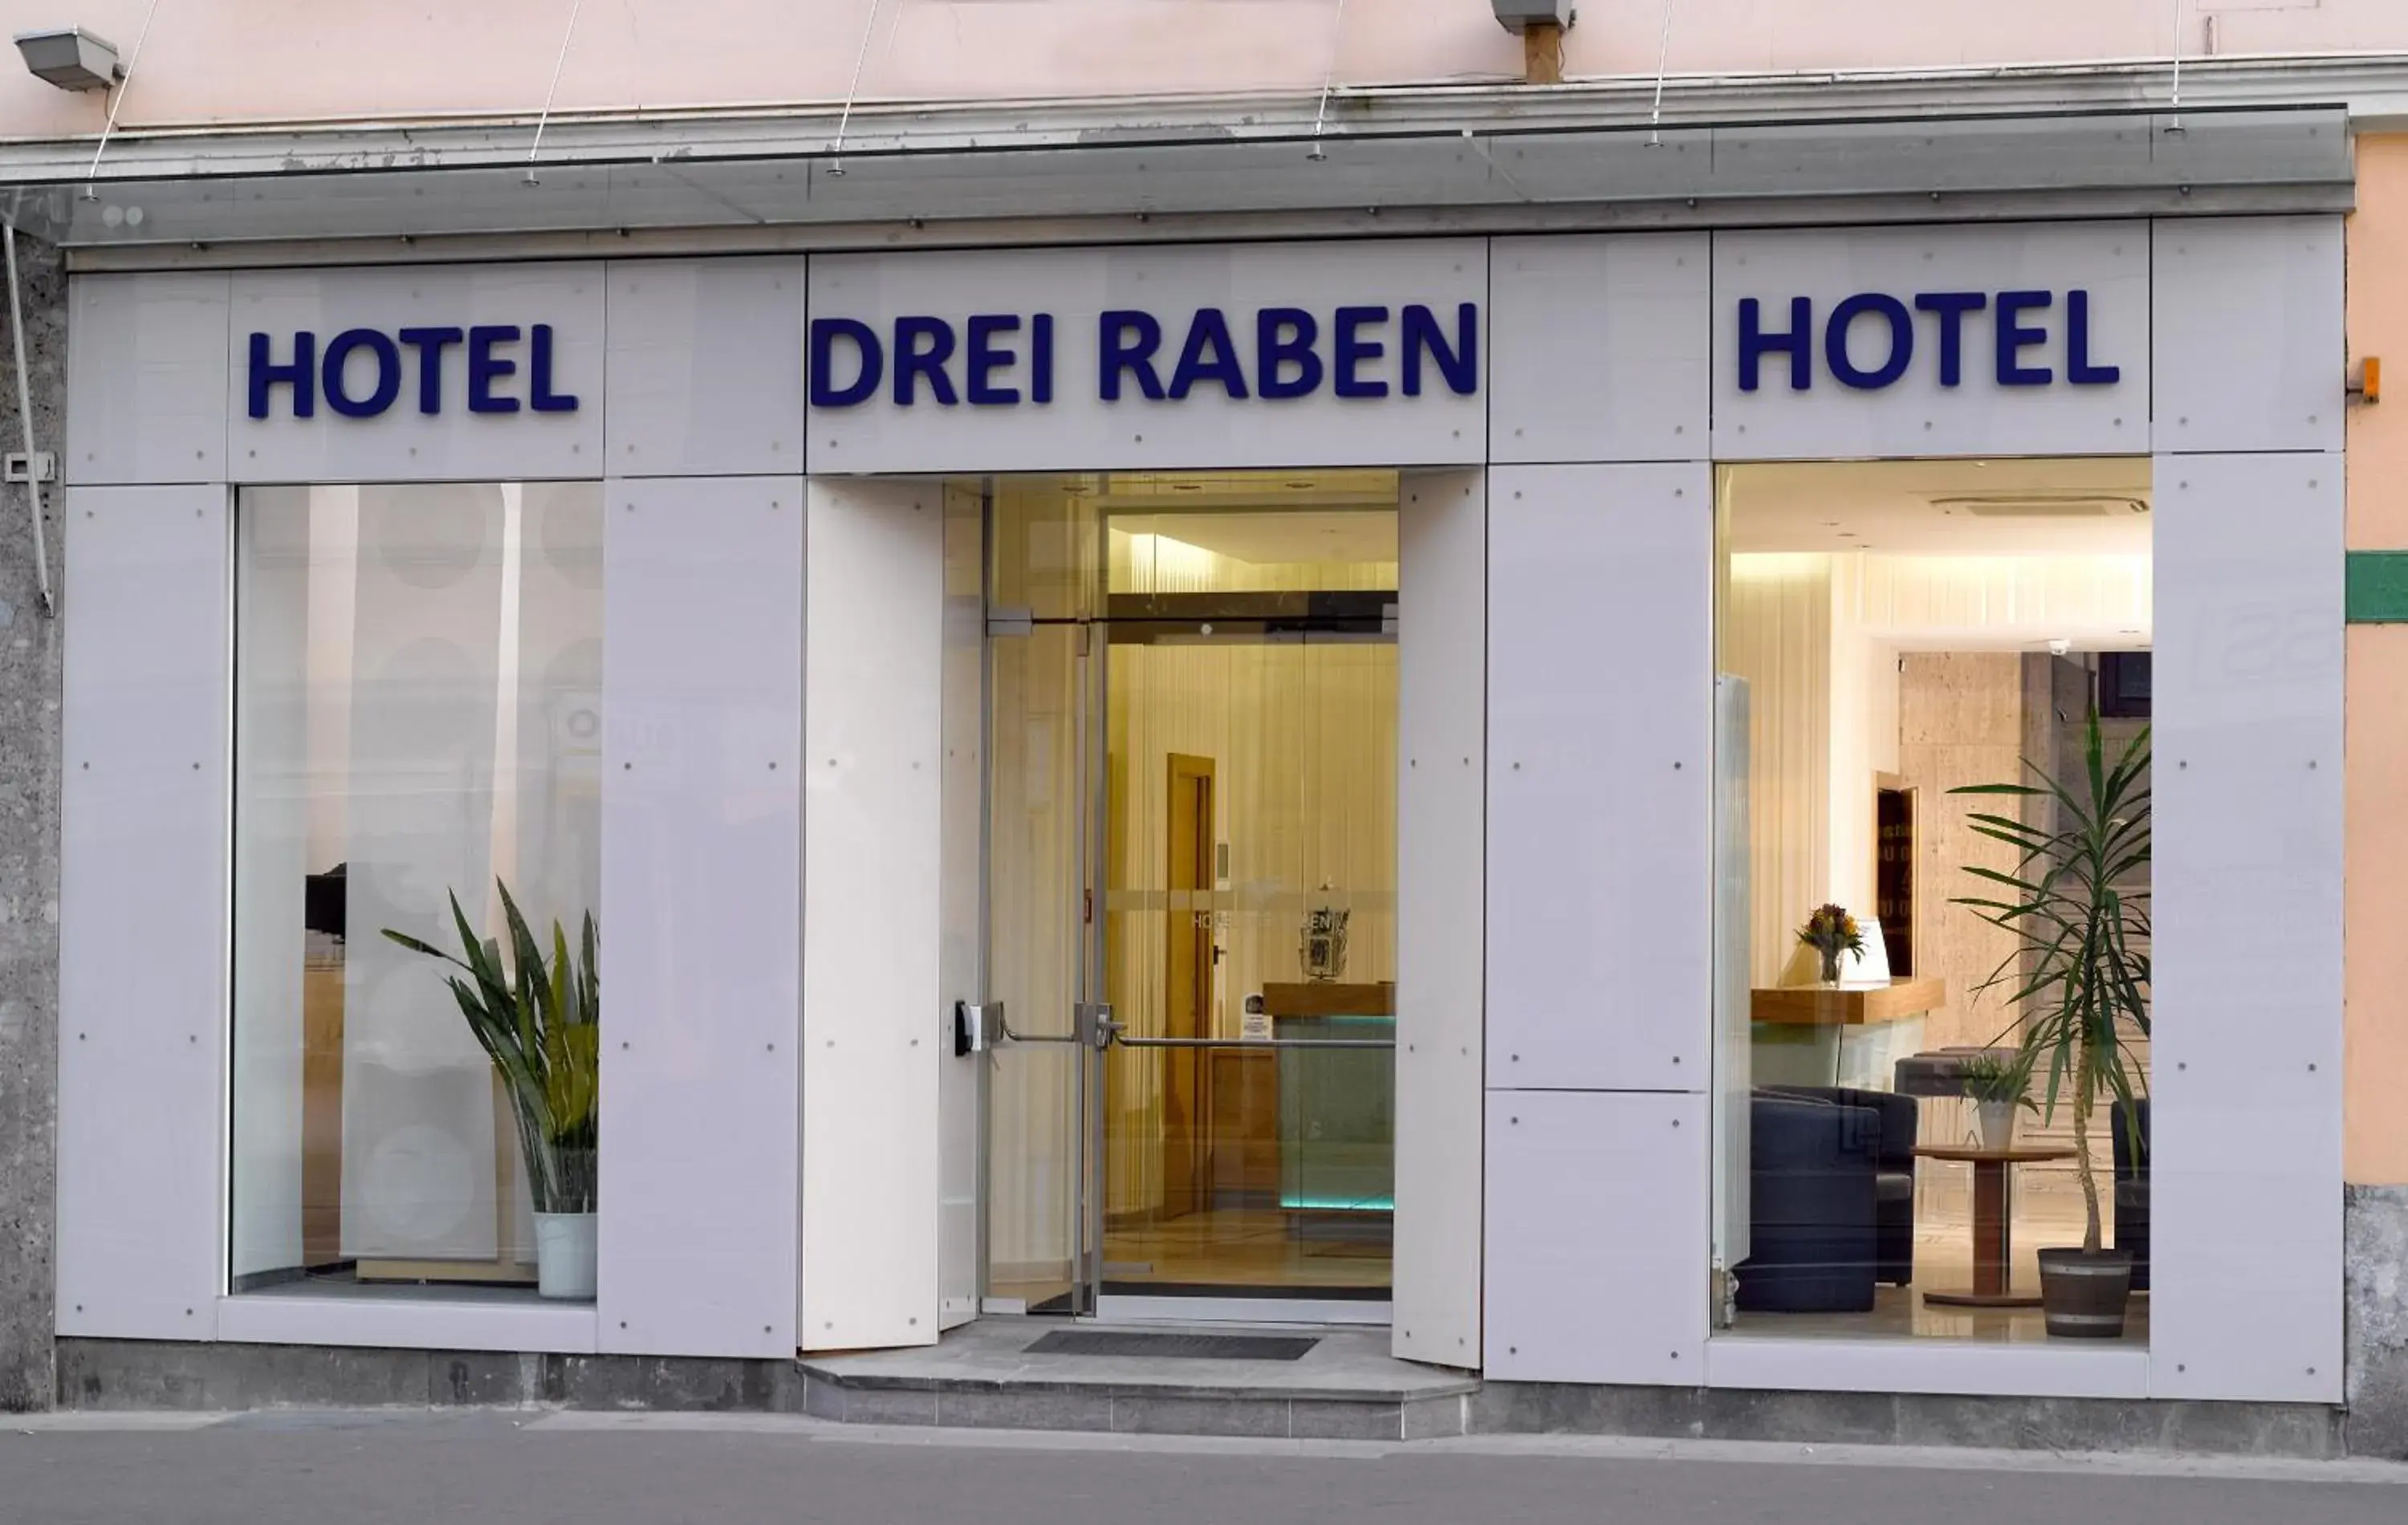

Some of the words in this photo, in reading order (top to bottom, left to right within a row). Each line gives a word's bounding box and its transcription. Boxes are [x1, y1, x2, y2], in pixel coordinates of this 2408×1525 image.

[248, 323, 579, 419] HOTEL
[810, 313, 1053, 408] DREI
[1099, 303, 1478, 400] RABEN
[1739, 290, 2120, 391] HOTEL
